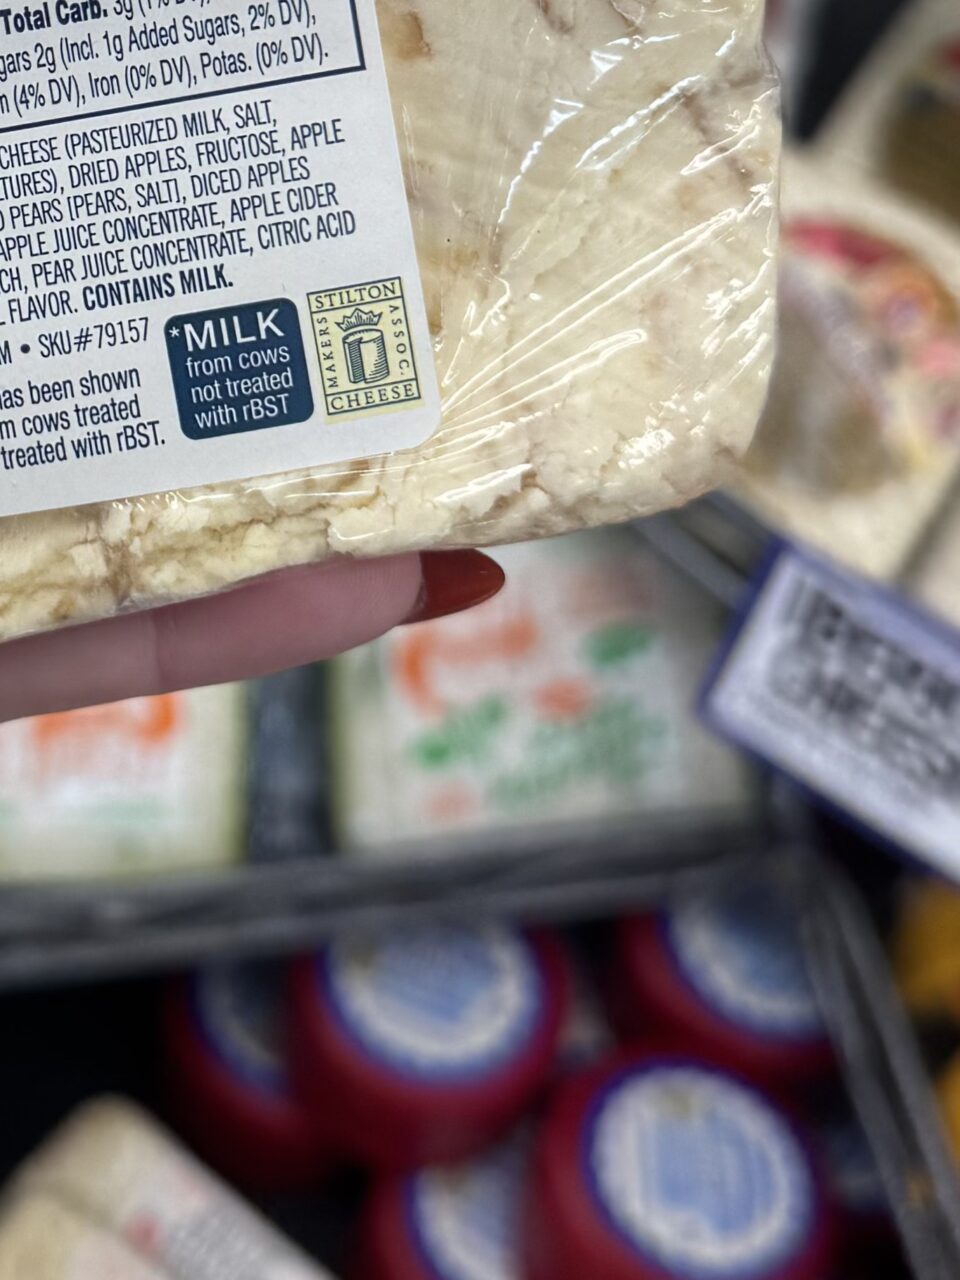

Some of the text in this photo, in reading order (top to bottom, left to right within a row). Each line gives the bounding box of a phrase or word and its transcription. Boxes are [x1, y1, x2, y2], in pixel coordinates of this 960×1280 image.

[128, 17, 180, 53] Added
[181, 13, 246, 46] Sugars,
[247, 2, 276, 32] 2%
[13, 82, 46, 118] (4%
[47, 74, 86, 109] DV),
[88, 71, 121, 98] Iron
[124, 62, 157, 99] (0%
[159, 55, 198, 89] DV),
[199, 50, 252, 79] Potas.
[255, 39, 289, 76] (0%
[290, 32, 329, 66] DV).
[64, 116, 178, 161] (PASTEURIZED
[181, 107, 231, 138] MILK,
[232, 99, 277, 129] SALT,
[67, 158, 120, 189] DRIED
[124, 145, 193, 180] APPLES,
[195, 129, 286, 167] FRUCTOSE,
[290, 118, 346, 152] APPLE
[8, 198, 64, 230] PEARS
[189, 167, 242, 199] DICED
[247, 155, 311, 190] APPLES
[52, 222, 101, 254] JUICE
[102, 201, 226, 245] CONCENTRATE,
[230, 190, 285, 224] APPLE
[286, 182, 339, 213] CIDER
[31, 257, 77, 289] PEAR
[81, 248, 129, 281] JUICE
[130, 227, 254, 272] CONCENTRATE,
[257, 217, 312, 250] CITRIC
[316, 209, 356, 240] ACID
[7, 289, 79, 325] FLAVOR.
[82, 272, 176, 311] CONTAINS
[178, 263, 234, 295] MILK.
[314, 281, 396, 309] STILTON
[37, 316, 149, 359] SKU#79157
[186, 346, 290, 378] from cows
[316, 316, 339, 389] MAKERS
[27, 379, 75, 405] been
[79, 367, 141, 397] shown
[191, 366, 294, 403] not treated
[330, 383, 415, 411] CHEESE
[21, 410, 71, 437] cows
[73, 393, 142, 428] treated
[194, 393, 289, 429] with rBST
[0, 435, 68, 471] treated
[70, 429, 112, 460] with
[116, 420, 166, 452] rBST.
